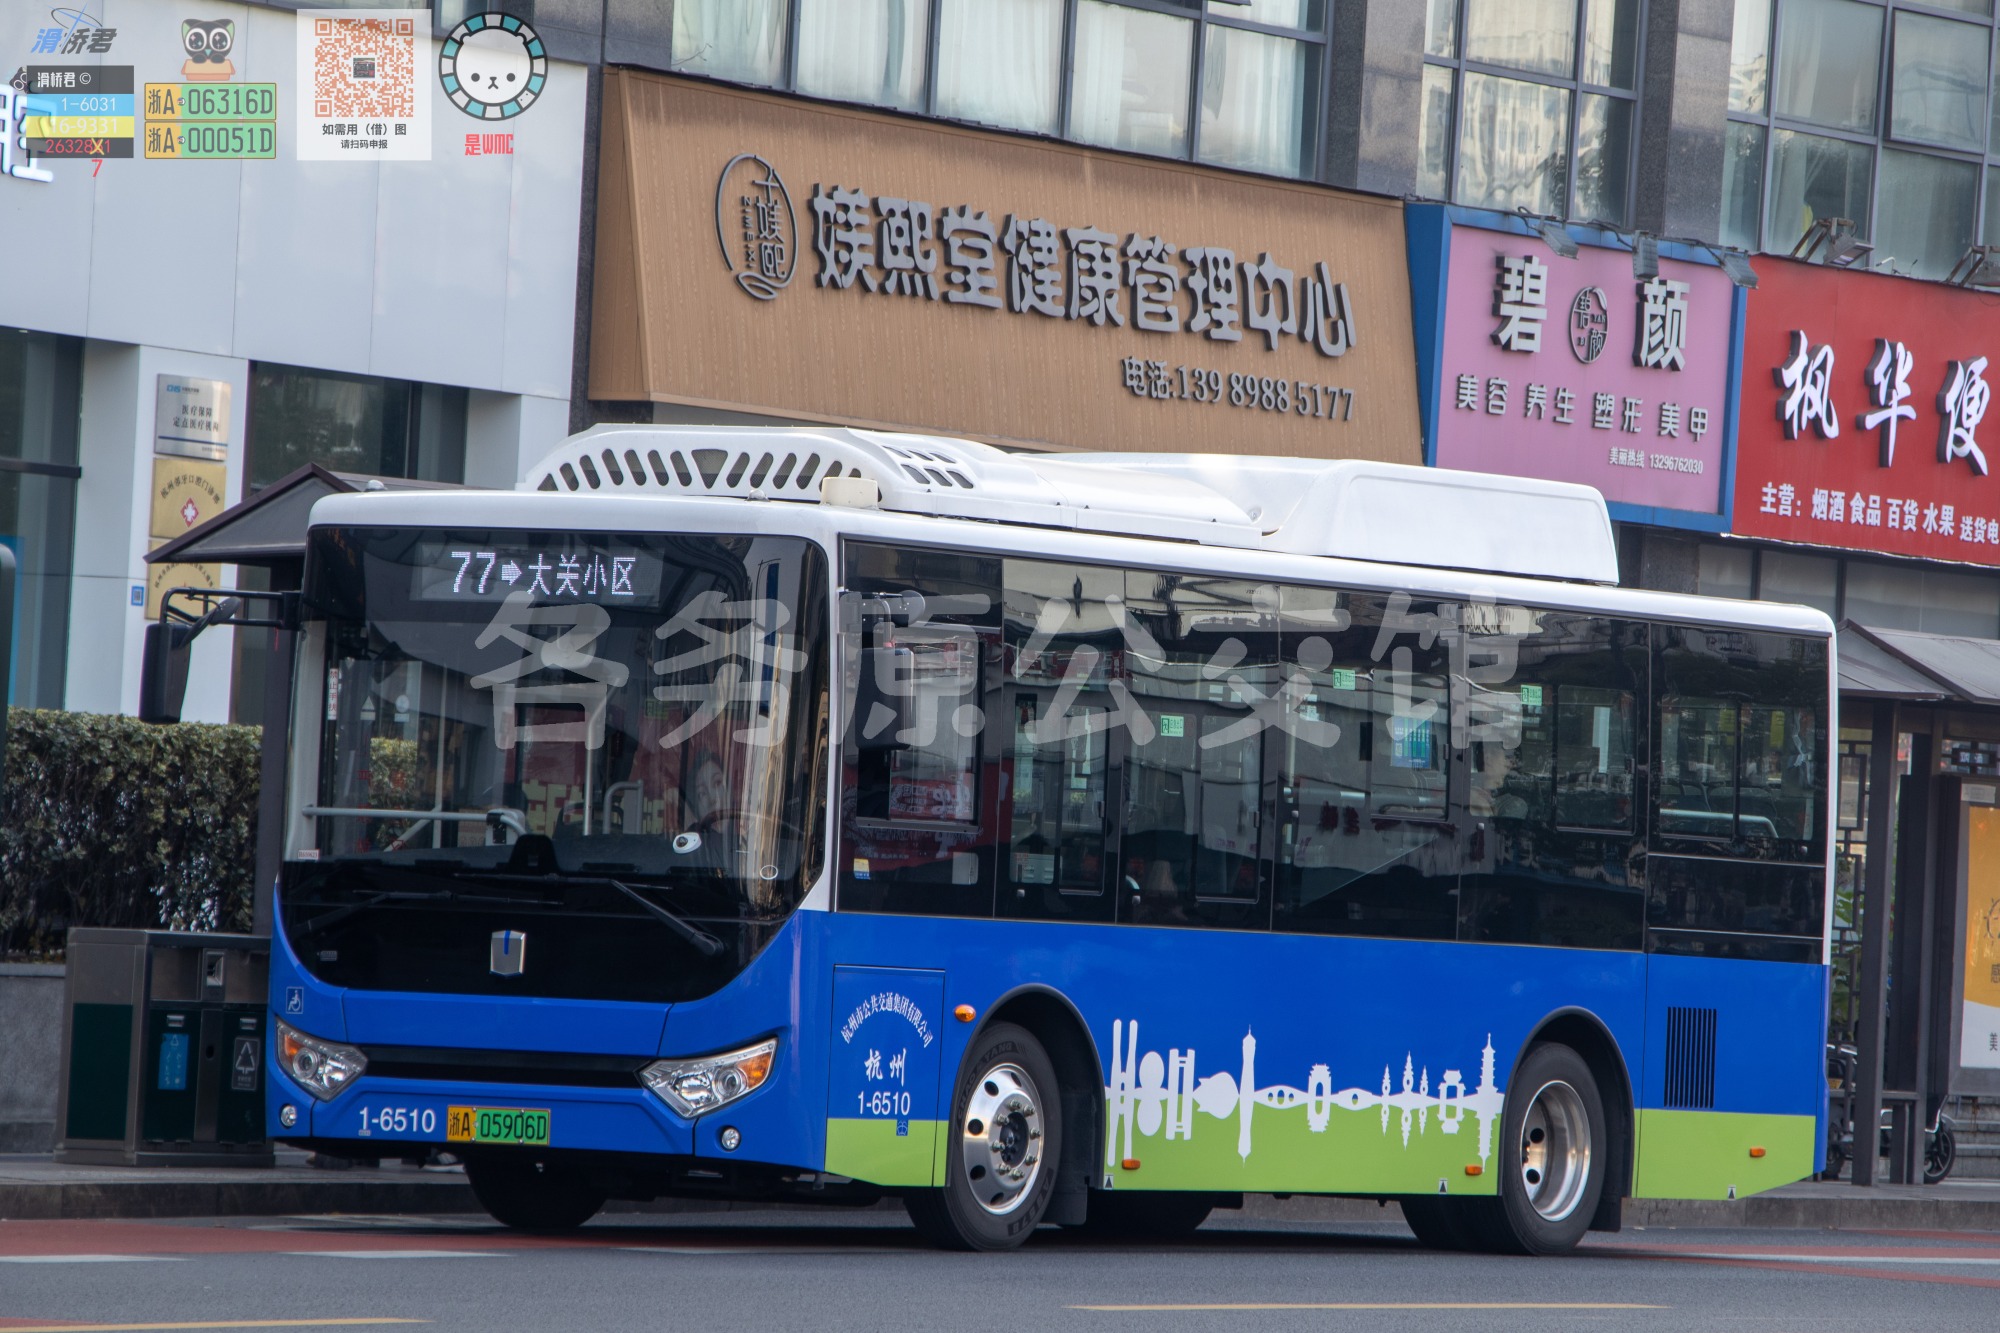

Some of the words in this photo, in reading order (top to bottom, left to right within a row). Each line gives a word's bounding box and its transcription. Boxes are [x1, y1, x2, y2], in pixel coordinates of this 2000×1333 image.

[1490, 255, 1548, 353] 碧
[1633, 278, 1691, 371] 颜
[1228, 372, 1291, 413] 8988
[1295, 380, 1354, 421] 5177
[1456, 374, 1509, 415] 美容
[1525, 383, 1576, 424] 养生
[1592, 392, 1643, 433] 塑形
[1658, 402, 1708, 442] 美甲
[1609, 446, 1645, 468] 美丽热线
[1649, 453, 1704, 474] 13296762030
[1811, 487, 1846, 523] 烟酒
[1850, 492, 1881, 527] 食品
[1886, 498, 1919, 532] 百货
[1922, 502, 1955, 536] 水果
[451, 551, 498, 594] 77
[528, 553, 637, 596] 大关小区
[840, 991, 934, 1049] 杭州市公共交通集团有限公司
[864, 1048, 908, 1087] 杭州
[359, 1106, 436, 1133] 1-6510
[857, 1090, 911, 1116] 1-6510
